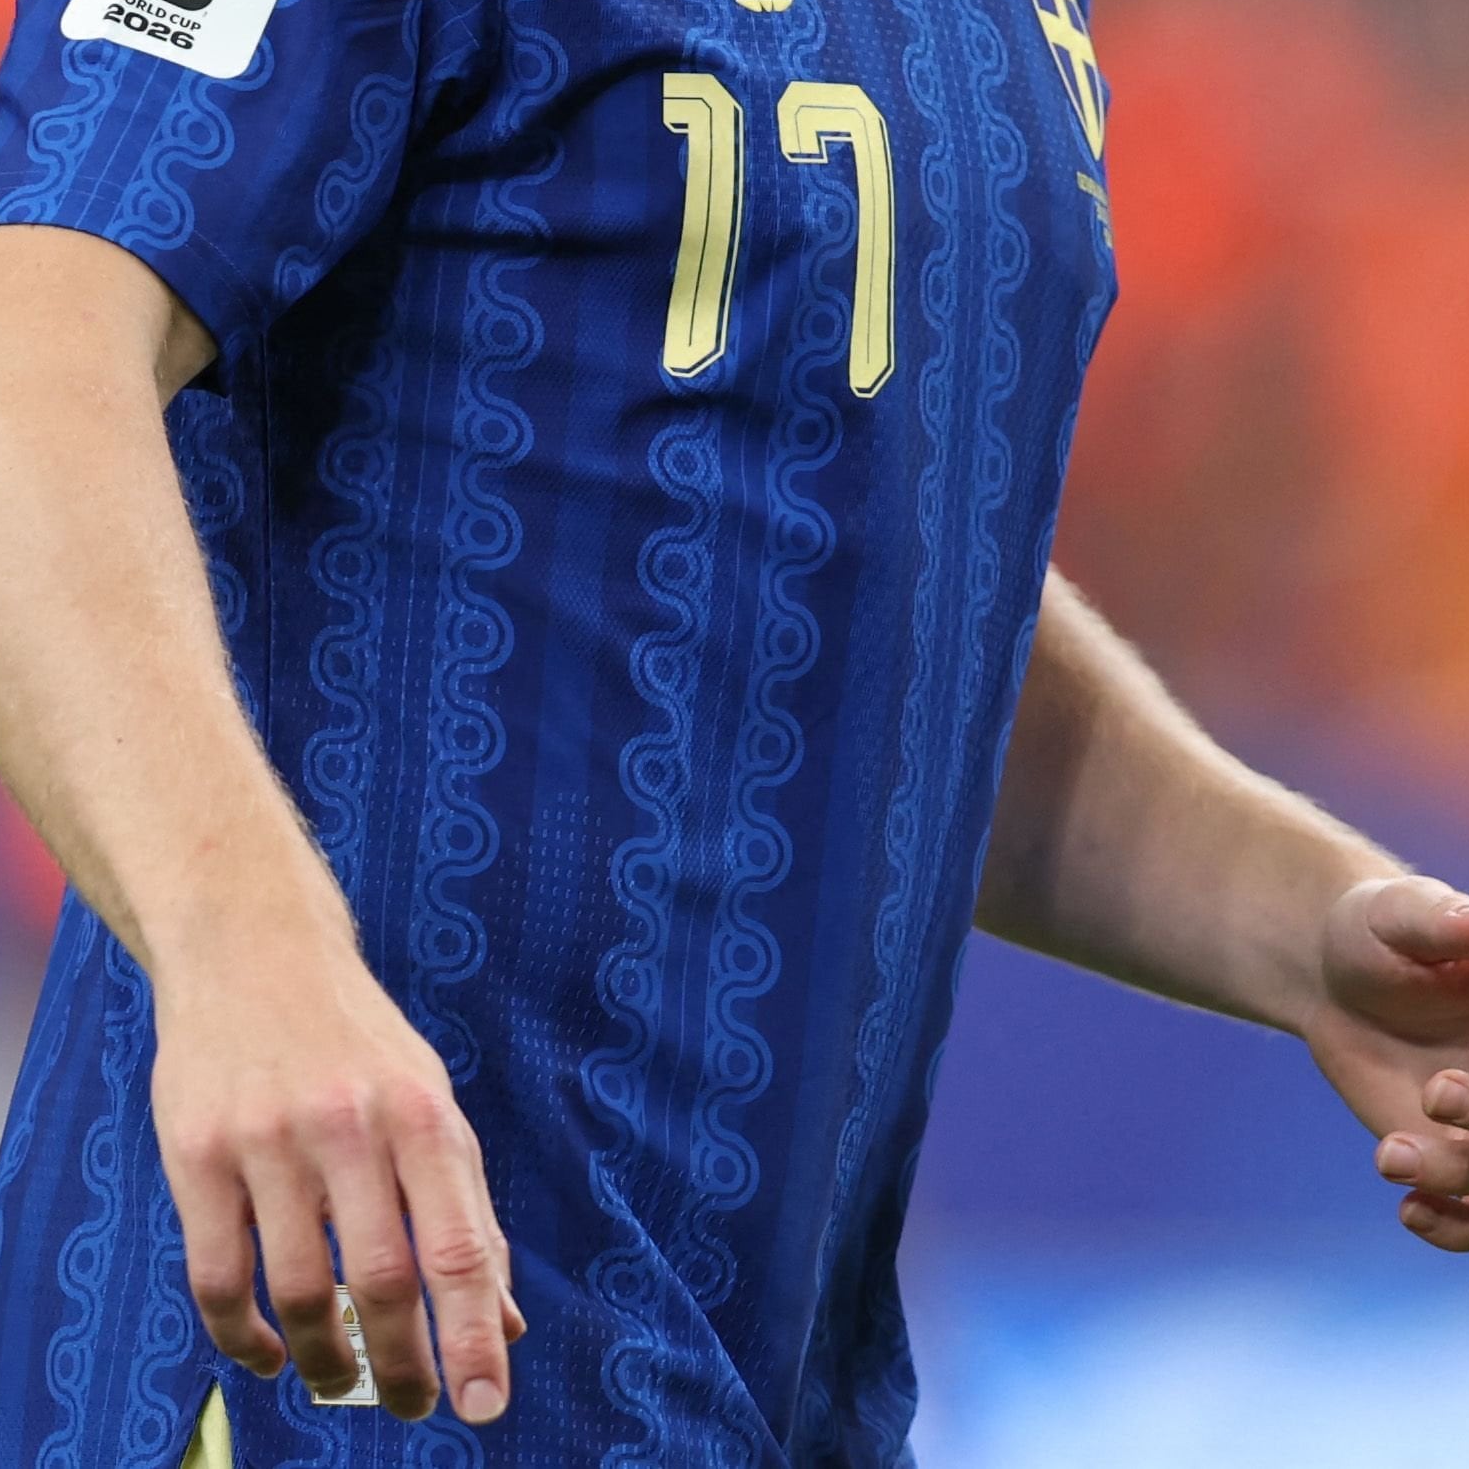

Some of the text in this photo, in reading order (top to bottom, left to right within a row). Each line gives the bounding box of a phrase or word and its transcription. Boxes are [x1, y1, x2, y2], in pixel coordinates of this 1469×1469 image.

[103, 3, 195, 50] 2026
[169, 13, 202, 31] CUP
[662, 72, 896, 399] 17
